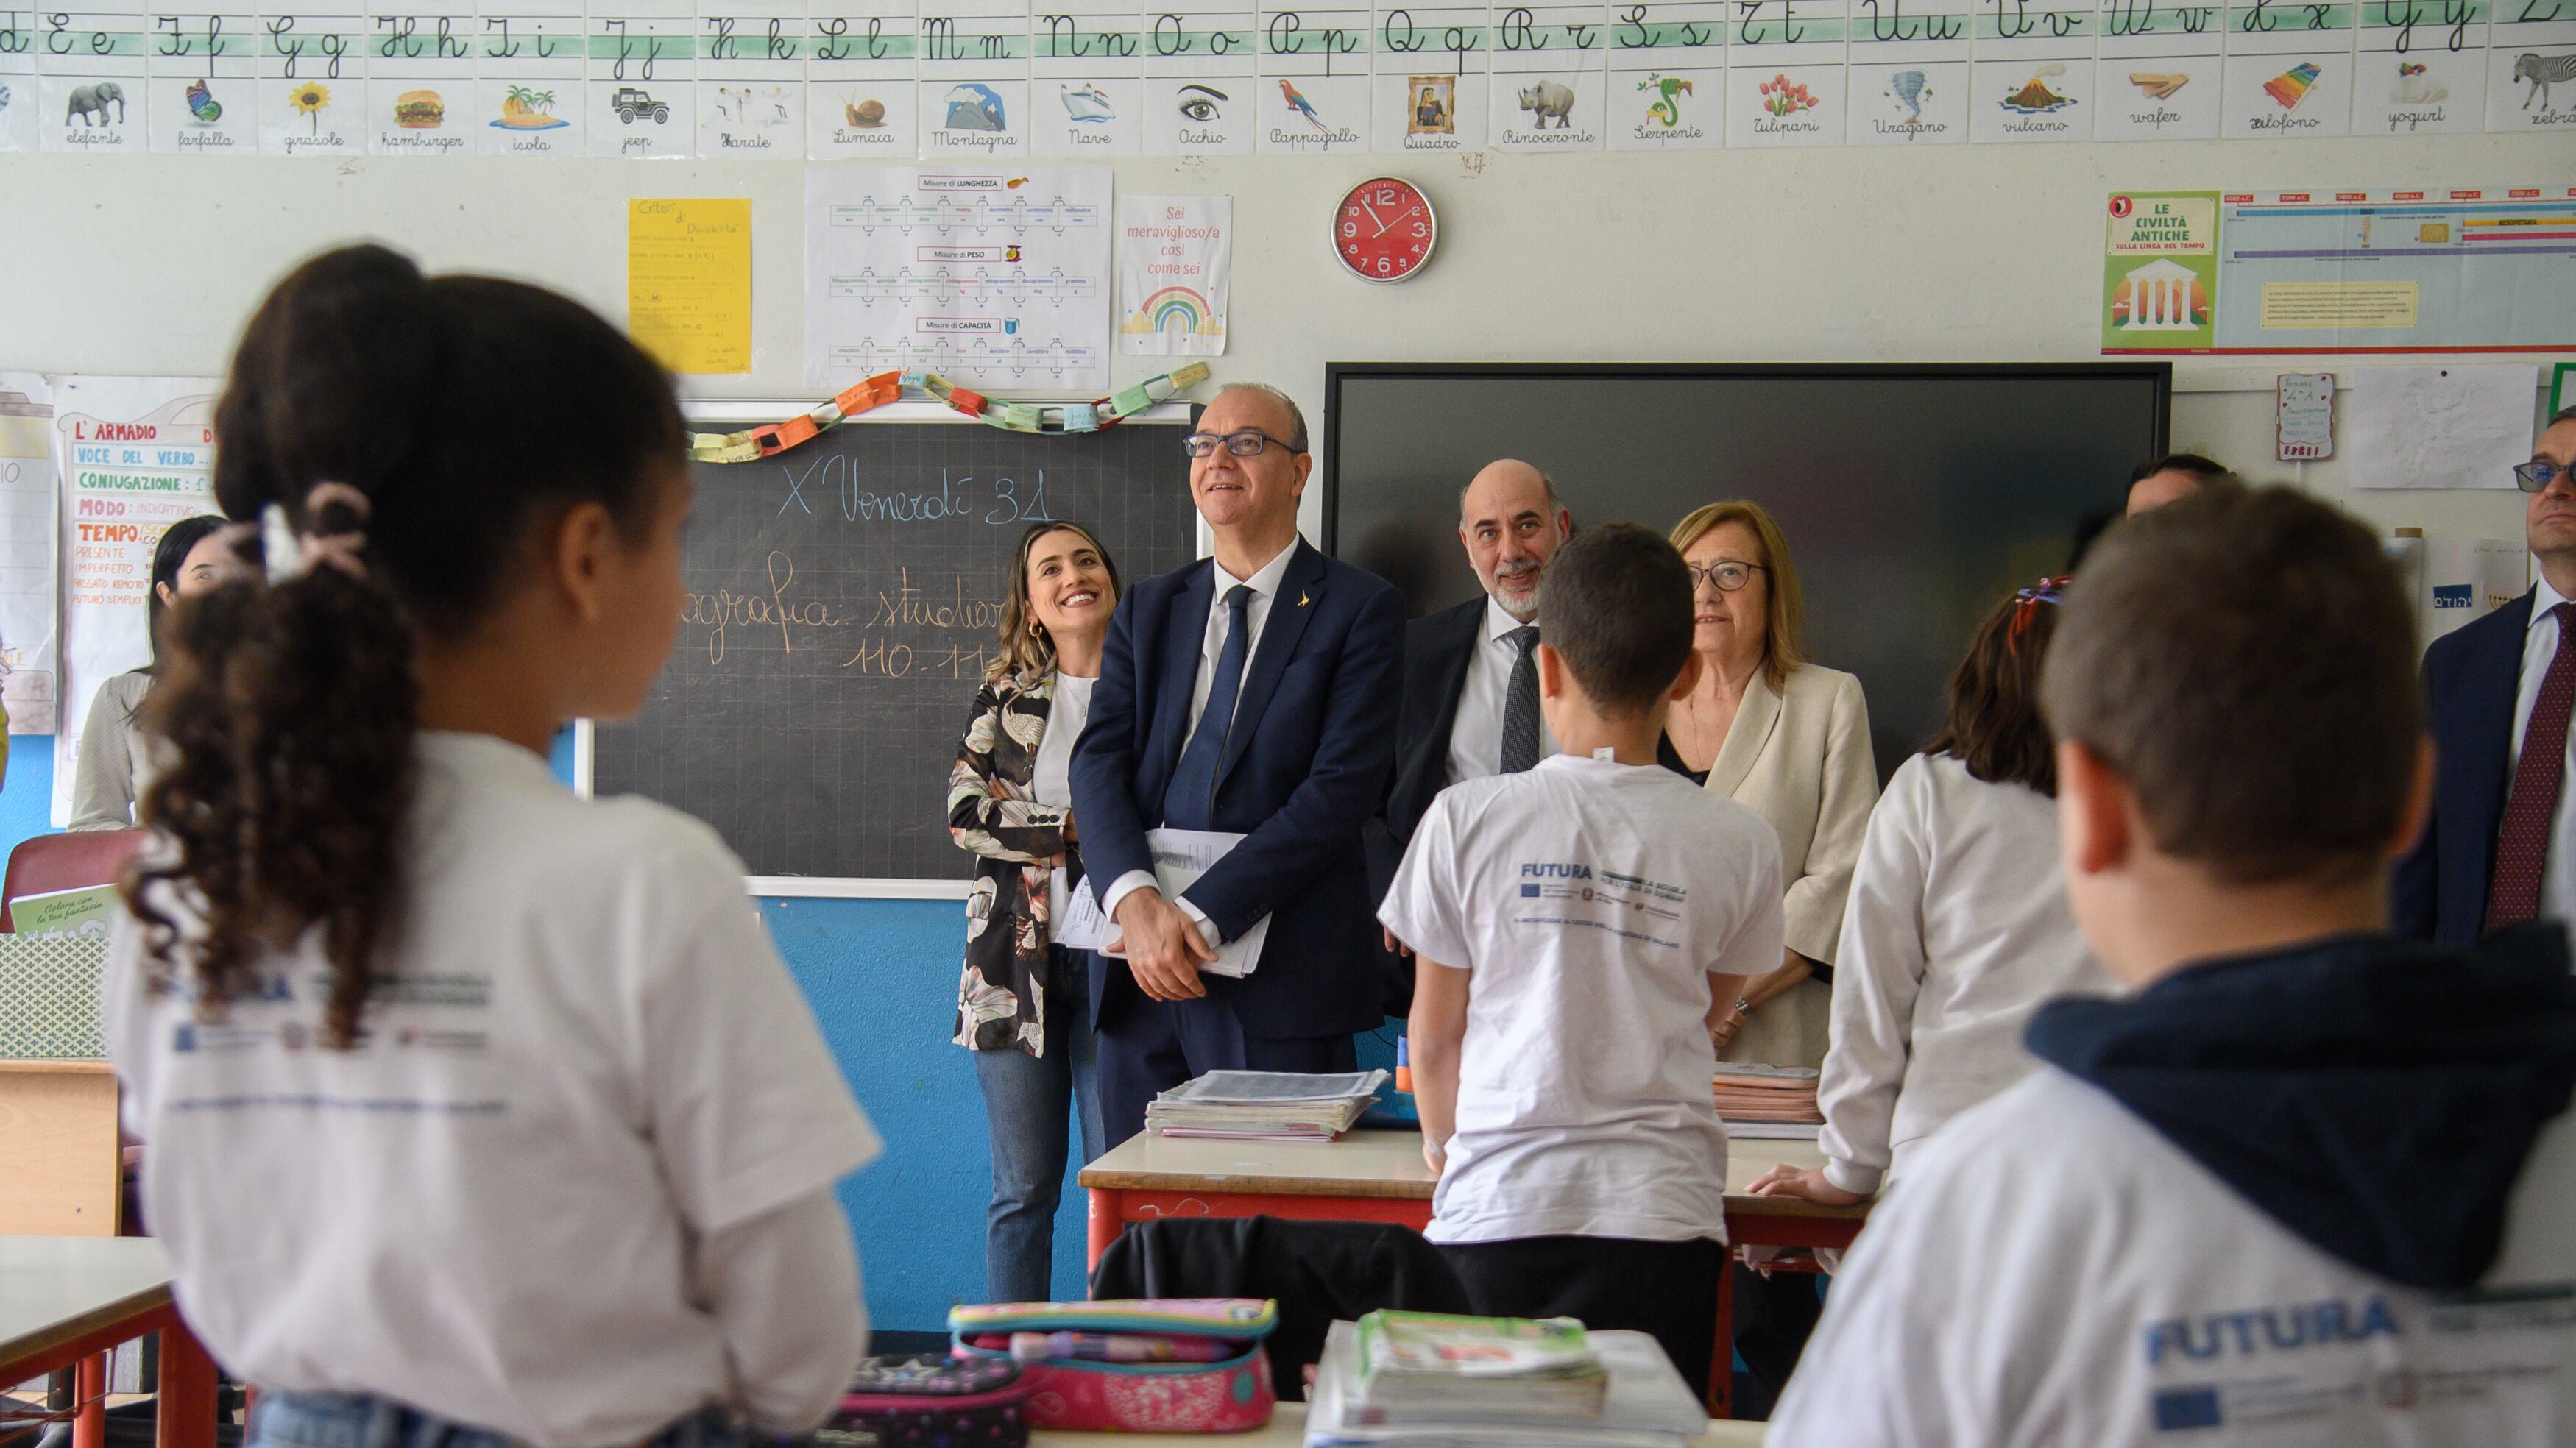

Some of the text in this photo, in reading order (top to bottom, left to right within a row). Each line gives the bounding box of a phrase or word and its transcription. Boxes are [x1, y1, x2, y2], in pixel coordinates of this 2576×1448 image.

[1740, 0, 1804, 44] T t
[1862, 0, 1961, 41] U u
[2043, 12, 2083, 37] v
[2176, 7, 2214, 33] w
[2307, 4, 2332, 31] x
[0, 11, 29, 53] d
[47, 13, 115, 54] E e
[1155, 14, 1240, 55] O o
[1502, 8, 1596, 51] R r
[1620, 5, 1711, 48] S s
[378, 16, 467, 57] H h
[487, 19, 555, 57] I i
[708, 18, 796, 60] K k
[818, 18, 887, 59] L l
[922, 17, 1011, 59] M m
[1043, 15, 1136, 57] N n
[1270, 12, 1356, 77] P p
[1385, 10, 1478, 76] Q q
[158, 15, 224, 77] F f
[267, 15, 347, 78] G g
[606, 19, 661, 79] J j
[1753, 117, 1821, 138] Tulipani
[2002, 118, 2069, 133] vulcano
[2129, 110, 2182, 129] wafer
[2249, 114, 2321, 135] xilofono
[2387, 108, 2446, 131] yogurt
[832, 129, 894, 144] Lumaca
[1068, 129, 1111, 144] Nave
[1178, 128, 1227, 144] Occhio
[1501, 129, 1596, 145] Rinoceronte
[1634, 124, 1704, 146] Serpente
[1873, 118, 1948, 141] Uragano
[66, 132, 124, 147] elefante
[177, 131, 235, 147] farfalla
[284, 132, 344, 153] girasole
[381, 132, 464, 152] hamburger
[513, 137, 551, 152] isola
[621, 135, 652, 154] jeep
[931, 130, 1018, 152] Montagna
[1269, 128, 1361, 150] Pappagallo
[1403, 135, 1462, 149] Quadro
[924, 180, 948, 188] Misure
[949, 180, 956, 188] di
[1376, 189, 1395, 205] 12
[1401, 194, 1405, 203] 1
[1167, 207, 1185, 220] Sei
[1348, 206, 1359, 216] 10
[1412, 206, 1420, 216] 2
[2154, 204, 2170, 214] LE
[1344, 222, 1356, 238] 9
[1412, 222, 1426, 238] 3
[2135, 215, 2187, 228] CIVILTÀ
[1128, 225, 1220, 241] meraviglioso/a
[2131, 230, 2190, 241] ANTICHE
[934, 251, 958, 259] Misure
[960, 251, 966, 259] di
[1348, 244, 1358, 254] 8
[1411, 244, 1420, 253] 4
[1147, 262, 1200, 274] come sei
[1361, 258, 1368, 268] 7
[1377, 257, 1390, 272] 6
[1399, 258, 1406, 267] 5
[926, 321, 991, 330] Misure di CAPACITÀ
[95, 423, 157, 440] ARMADIO
[77, 448, 195, 465] VOCE DEL VERBO
[822, 455, 974, 521] Venerdì
[986, 469, 1055, 525] 31
[76, 546, 126, 558] PRESENTE
[75, 562, 134, 574] IMPERFETTO
[74, 578, 144, 589] PASSATO REMOTO
[71, 594, 142, 605] FUTURO SEMPLICE
[866, 567, 1006, 628] studiar
[1521, 863, 1593, 879] FUTURA
[37, 902, 103, 924] la tua fantasia
[44, 896, 94, 913] Colora con
[2145, 1295, 2400, 1365] FUTURA
